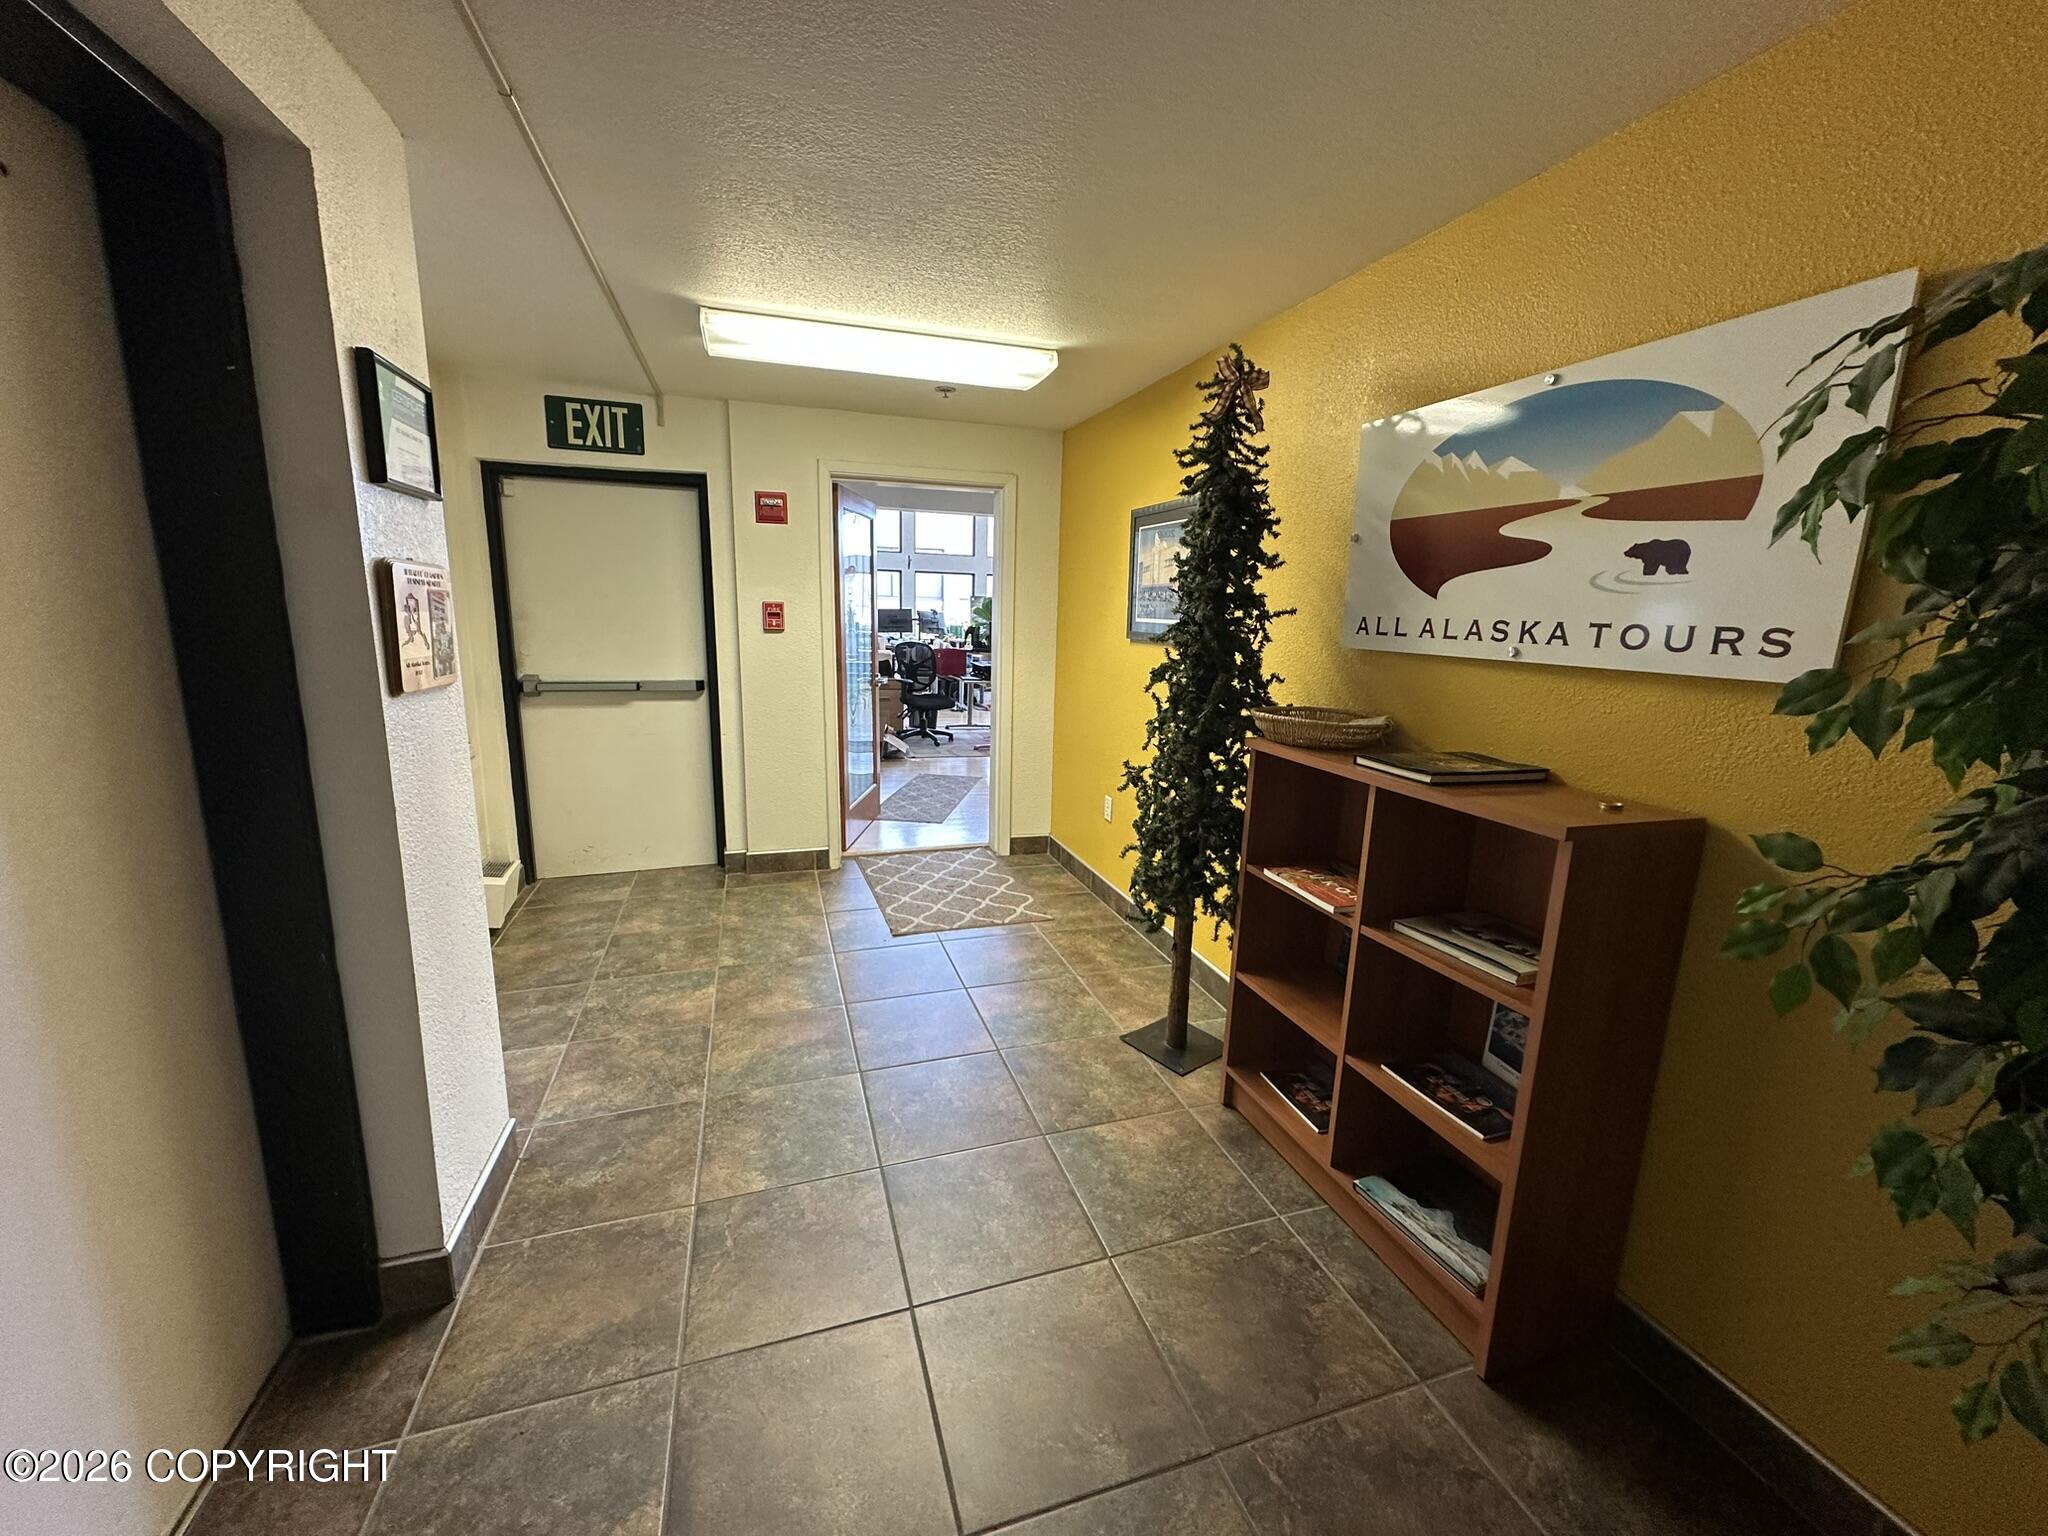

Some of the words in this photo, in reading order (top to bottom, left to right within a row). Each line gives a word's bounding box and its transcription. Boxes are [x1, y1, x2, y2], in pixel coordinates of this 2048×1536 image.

[565, 401, 628, 449] EXIT
[1355, 616, 1408, 638] ALL
[1418, 618, 1570, 646] ALASKA
[1588, 621, 1796, 658] TOURS
